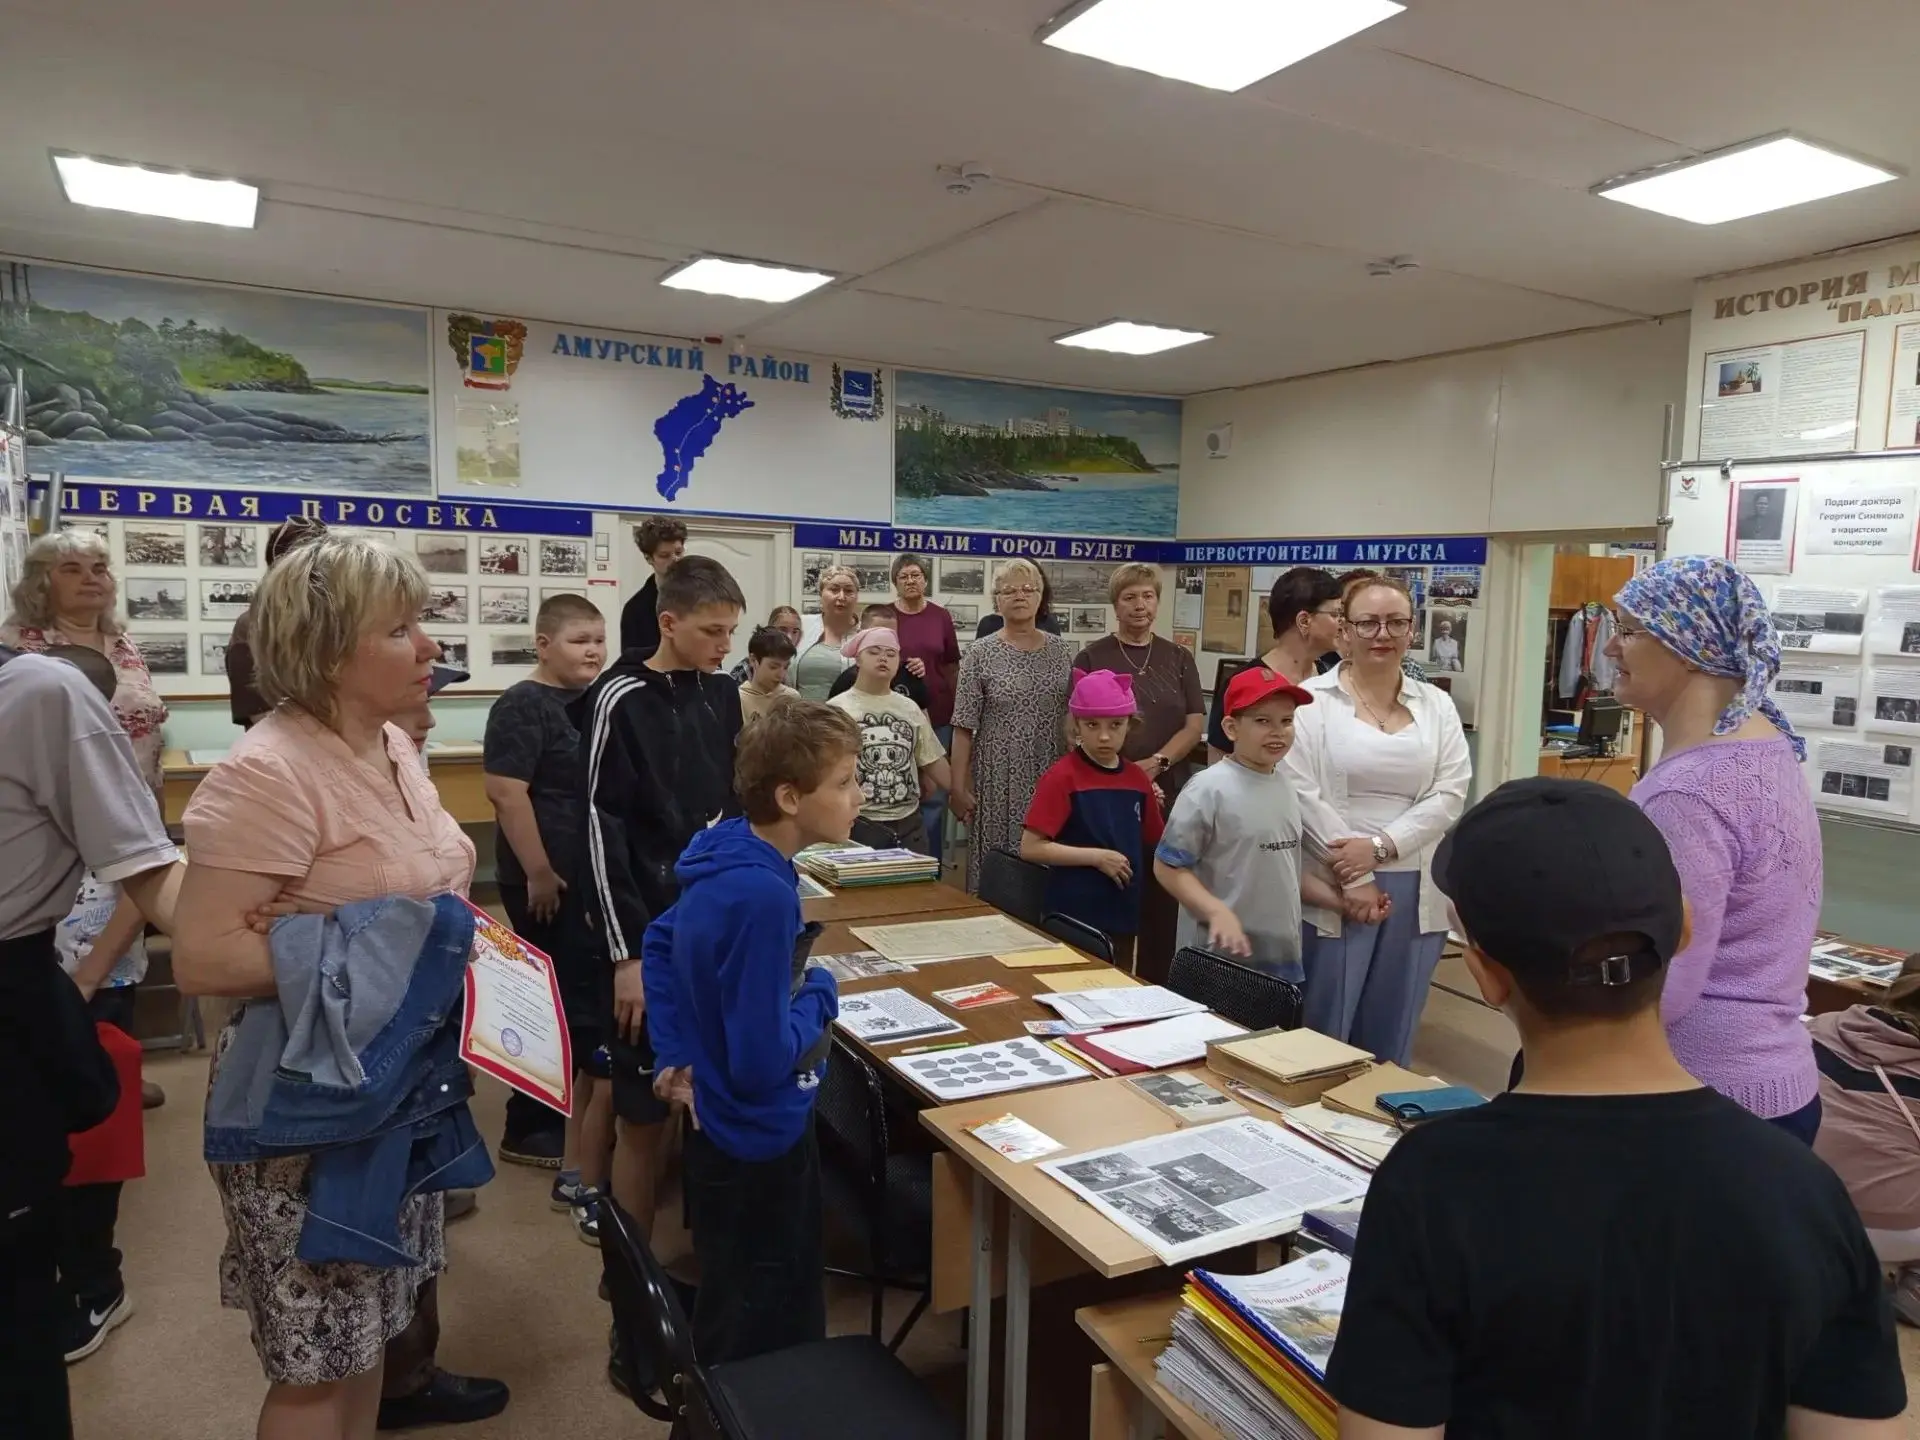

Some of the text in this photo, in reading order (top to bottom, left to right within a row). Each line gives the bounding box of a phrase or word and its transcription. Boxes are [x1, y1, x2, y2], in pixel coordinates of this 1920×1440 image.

[1713, 270, 1869, 320] ИСТОРИЯ
[551, 333, 811, 384] АМУРСКИЙ РАЙОН
[60, 488, 499, 529] ПЕРВАЯ ПРОСЕКА
[1824, 497, 1902, 507] Подвиг доктора
[838, 529, 881, 548] МЫ
[990, 537, 1057, 558] ГОРОД
[1070, 541, 1137, 561] БУДЕТ
[1184, 542, 1448, 562] ПЕРВОСТРОИТЕЛИ АМУРСКА
